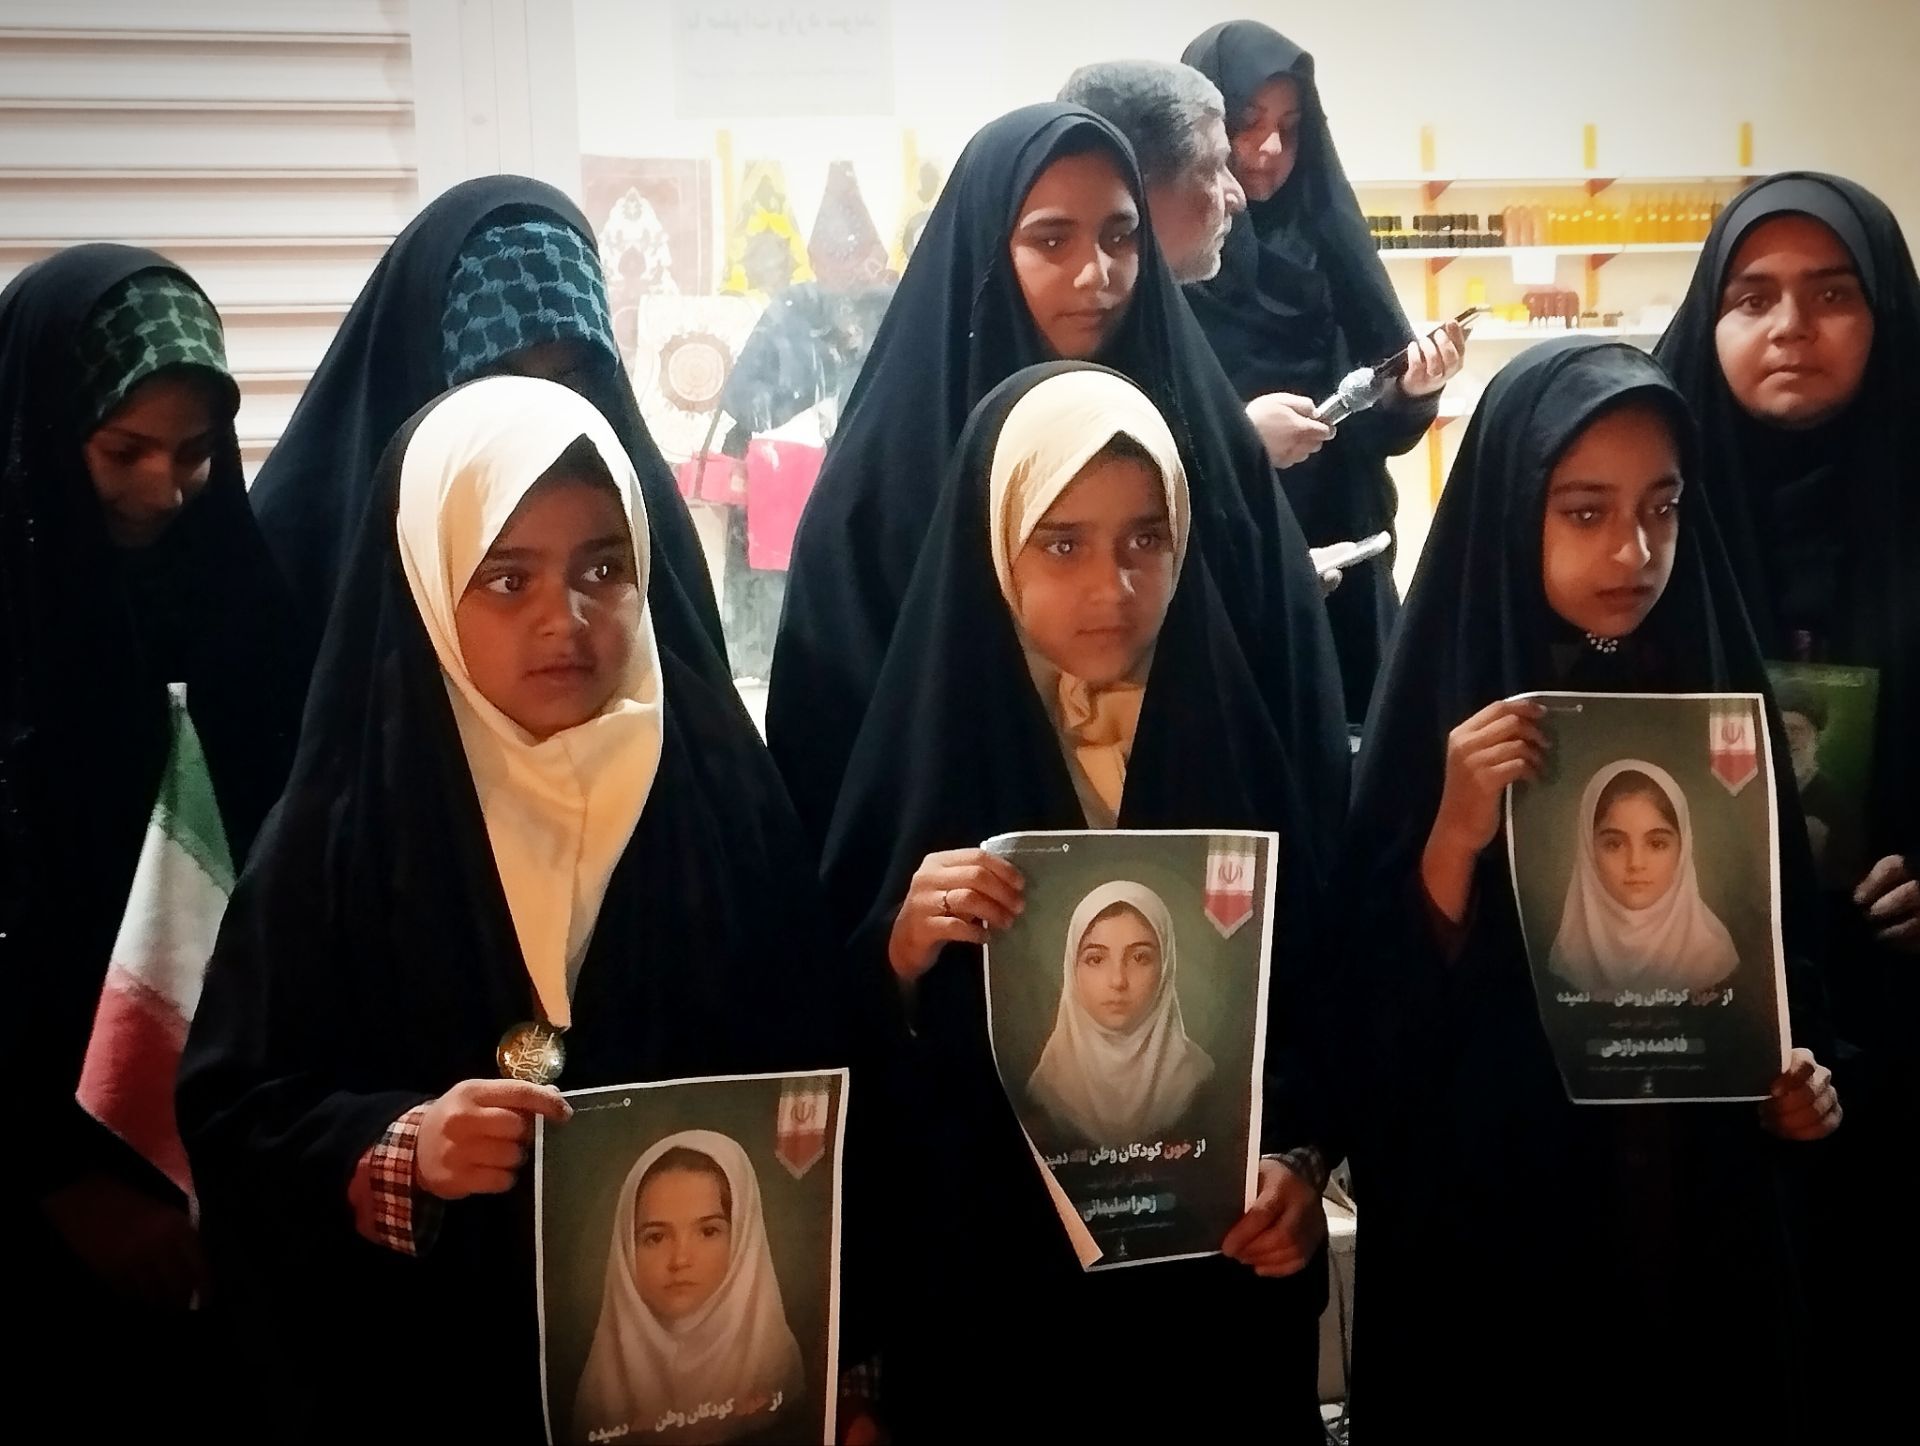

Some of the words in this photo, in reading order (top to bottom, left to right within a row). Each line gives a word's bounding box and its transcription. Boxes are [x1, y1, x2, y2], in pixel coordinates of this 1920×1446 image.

[1613, 989, 1643, 1007] وطن
[1644, 987, 1690, 1007] کودکان
[1721, 987, 1734, 1007] از
[1646, 1033, 1688, 1053] فاطمه
[1089, 1145, 1117, 1166] وطن
[1118, 1141, 1163, 1163] کودکان
[1163, 1139, 1192, 1161] خون
[1193, 1138, 1206, 1159] از
[1083, 1196, 1131, 1222] سلیمانی
[1130, 1194, 1157, 1215] زهرا
[687, 1397, 735, 1425] کودکان
[768, 1390, 784, 1412] از
[655, 1409, 686, 1432] وطن
[588, 1423, 630, 1444] دمیده
